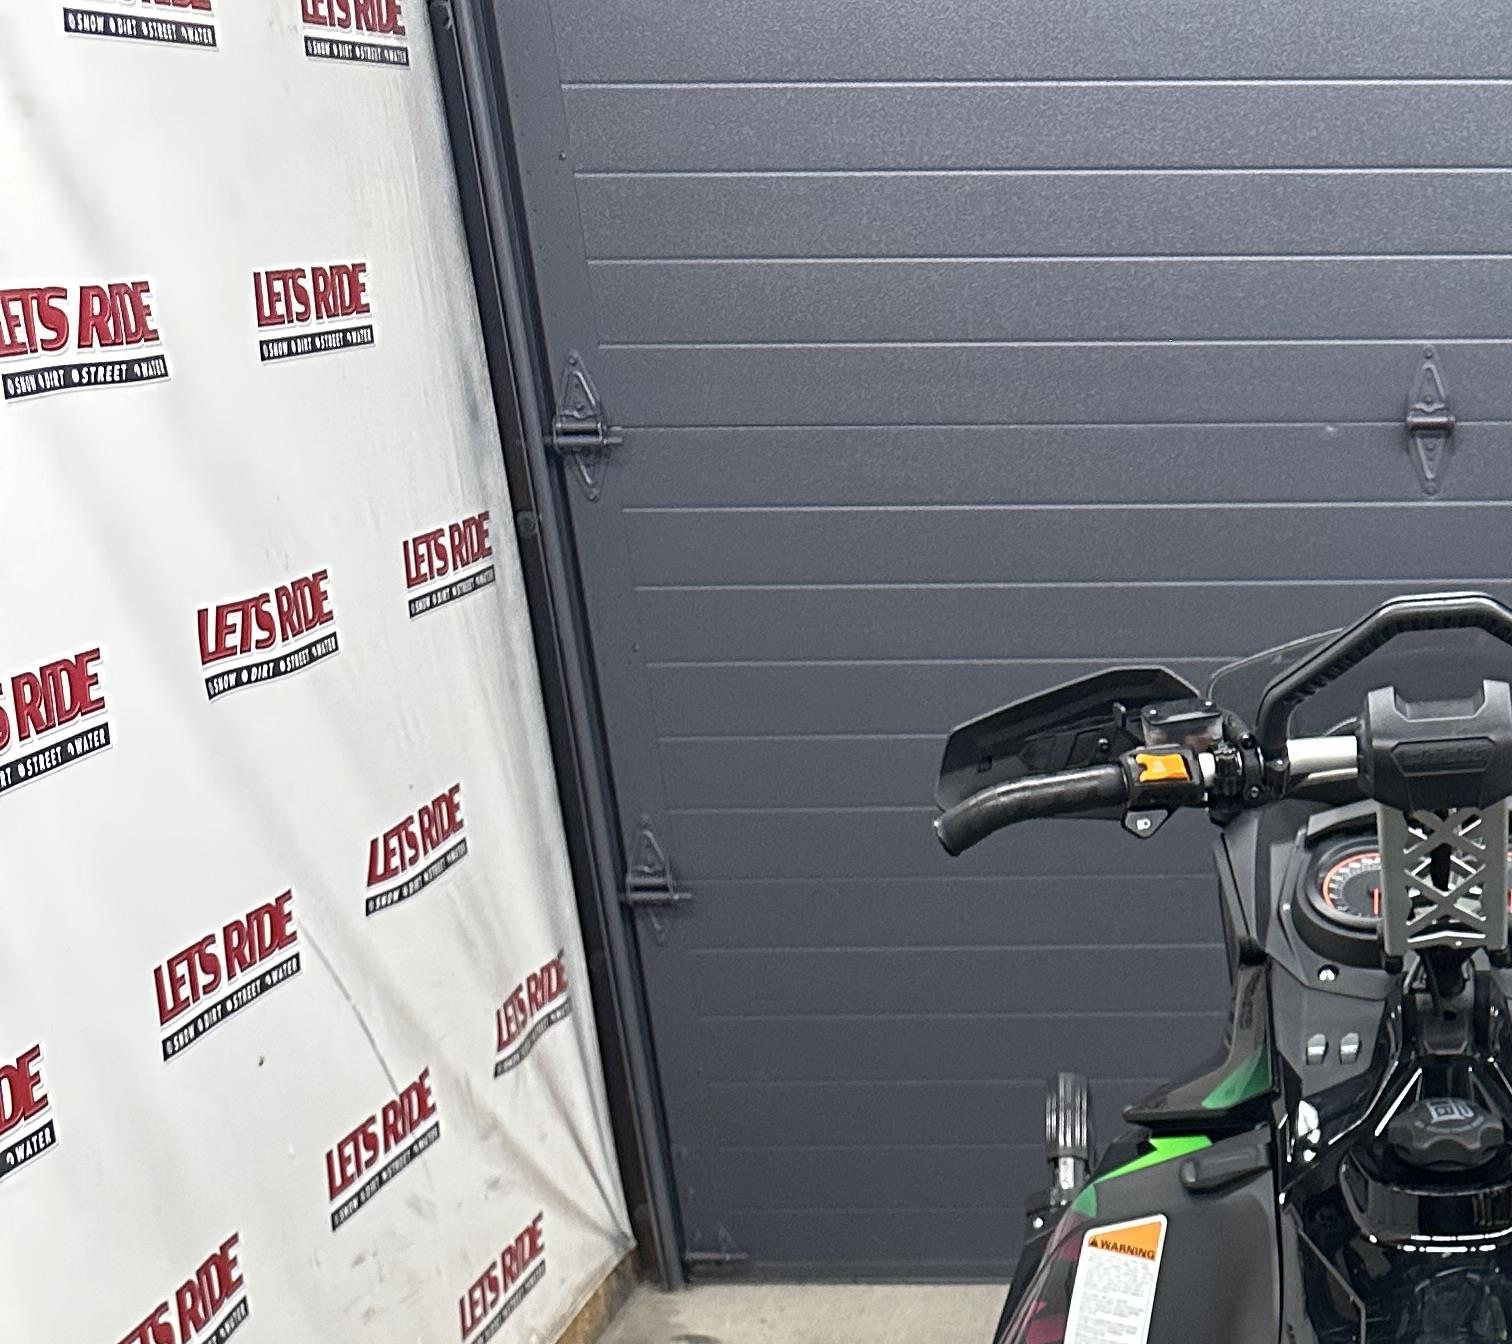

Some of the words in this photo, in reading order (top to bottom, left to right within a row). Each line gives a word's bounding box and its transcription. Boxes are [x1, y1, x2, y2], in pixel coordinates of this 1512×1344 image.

[117, 18, 137, 36] DIRT
[148, 21, 177, 40] STREET
[186, 26, 213, 44] WATER
[354, 0, 406, 36] RIDE
[78, 281, 160, 348] RIDE
[253, 268, 311, 328] LETS
[311, 263, 370, 320] RIDE
[44, 368, 65, 389] DIRT
[82, 363, 127, 383] STREET
[403, 528, 449, 589] LETS
[449, 510, 493, 571] RIDE
[197, 593, 277, 666] LETS
[275, 568, 334, 642] RIDE
[11, 647, 105, 741] RIDE
[250, 662, 275, 682] DIRT
[26, 746, 62, 777] STREET
[75, 728, 106, 755] WATER
[367, 814, 420, 888] LETS
[418, 783, 464, 857] RIDE
[153, 933, 222, 1027] LETS
[223, 888, 298, 981] RIDE
[232, 980, 262, 1009] STREET
[496, 982, 528, 1053] LETS
[0, 1044, 49, 1136] DE
[15, 1127, 52, 1163] WATER
[326, 1113, 380, 1201] LETS
[382, 1065, 437, 1154] RIDE
[459, 1260, 500, 1344] LETS
[500, 1210, 545, 1294] RIDE
[1100, 1238, 1155, 1261] WARNING
